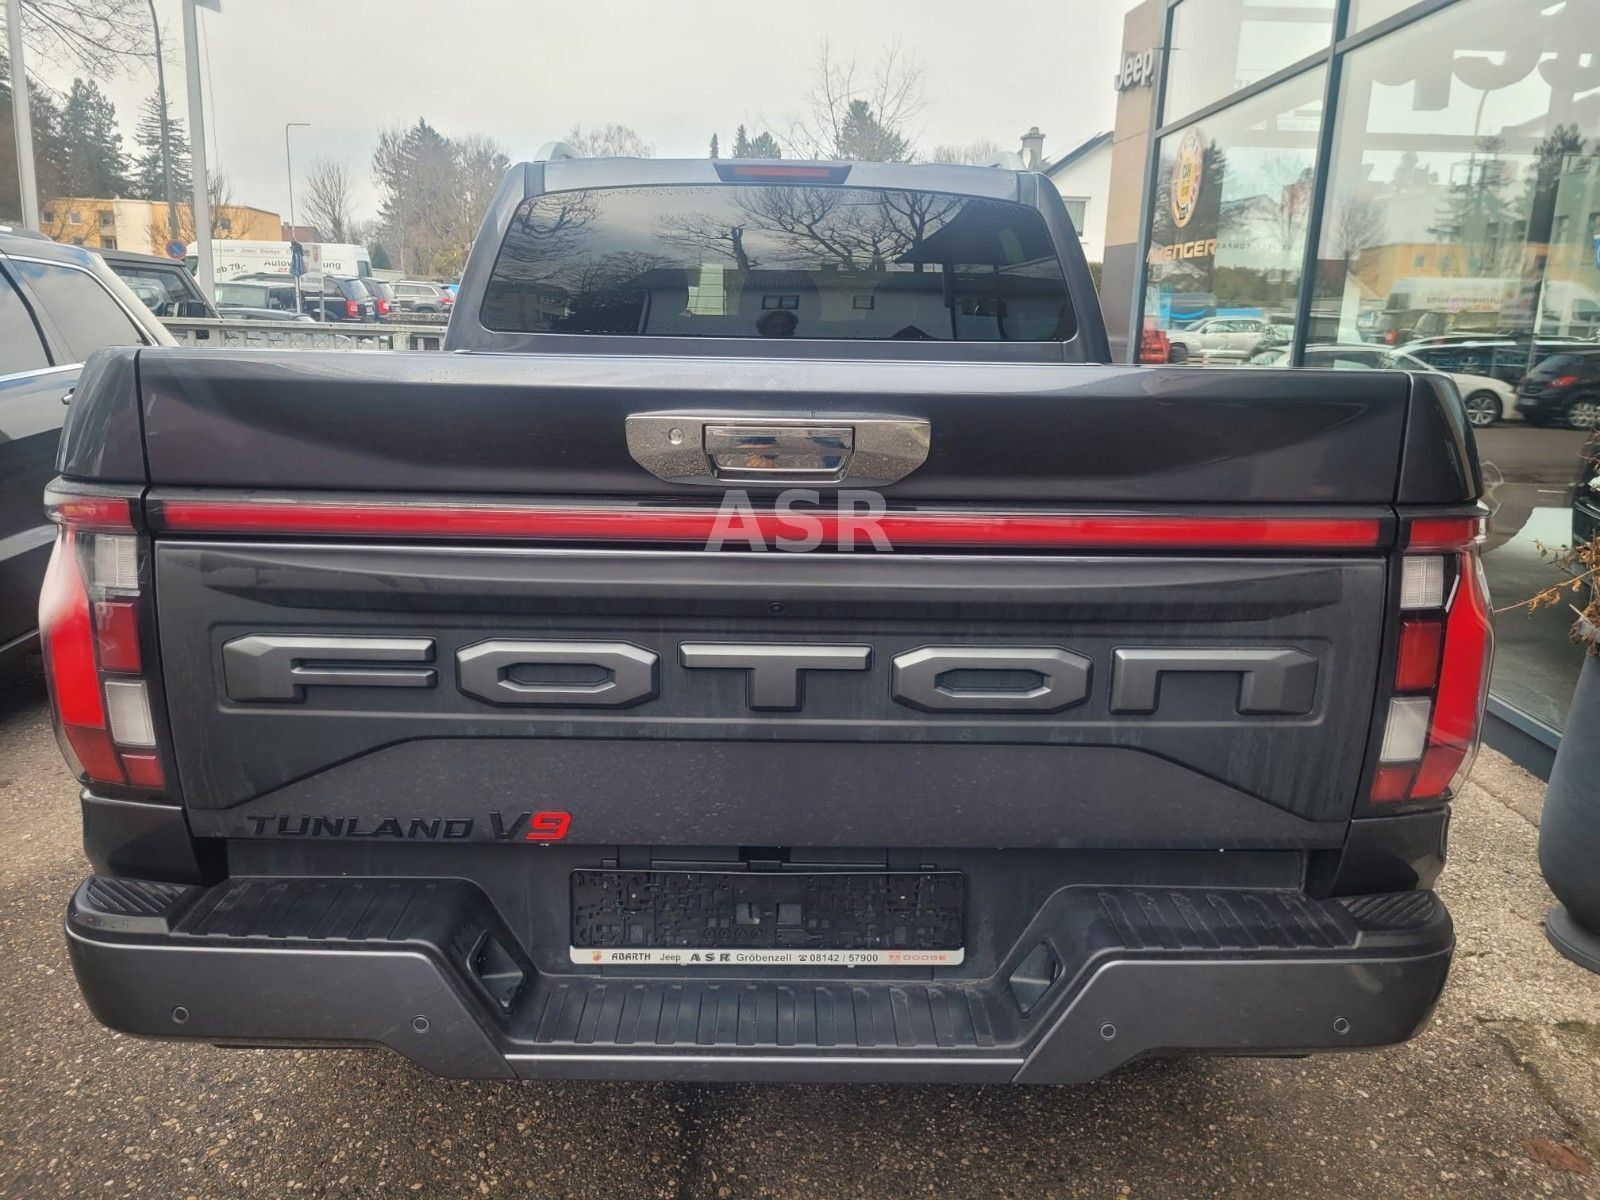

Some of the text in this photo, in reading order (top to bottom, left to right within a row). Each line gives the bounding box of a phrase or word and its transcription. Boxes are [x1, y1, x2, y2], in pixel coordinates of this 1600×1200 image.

[1114, 50, 1153, 91] Jeep
[222, 633, 1320, 716] FOTON
[247, 810, 573, 840] TUNLAND V9
[611, 952, 651, 961] ABARTH
[660, 953, 681, 962] Jeep
[736, 953, 792, 962] Gröbenzell
[809, 954, 840, 963] 08142
[849, 954, 879, 963] 57900
